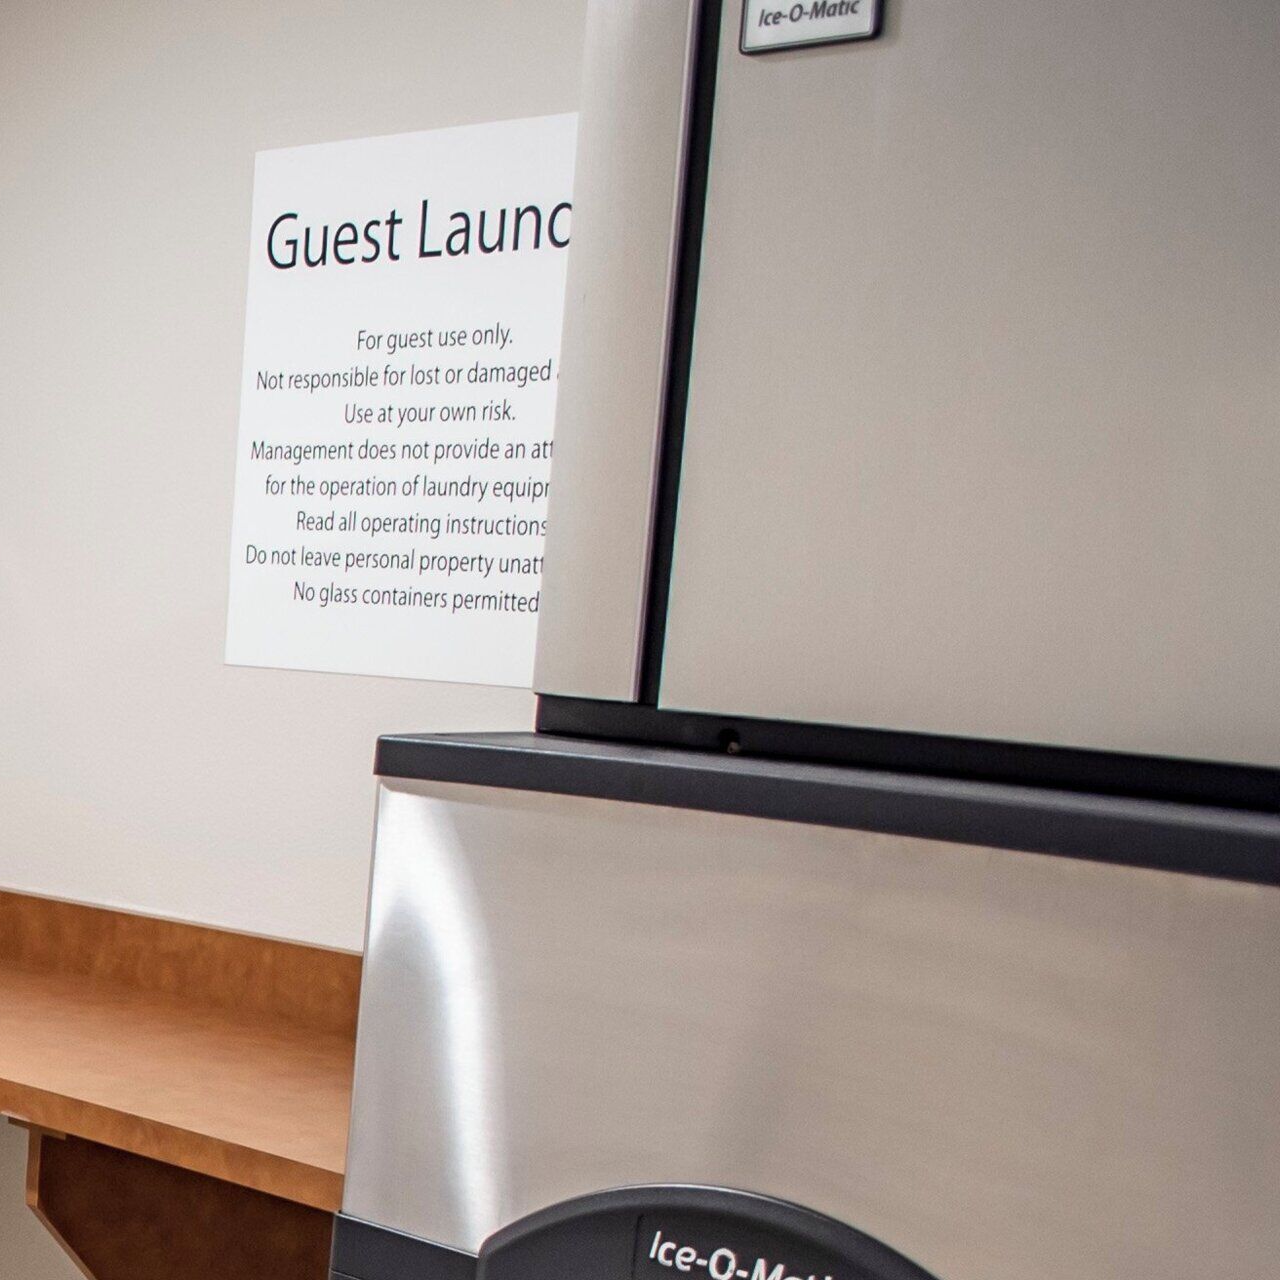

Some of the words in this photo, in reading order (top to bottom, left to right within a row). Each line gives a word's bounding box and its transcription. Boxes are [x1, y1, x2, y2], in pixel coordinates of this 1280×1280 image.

[758, 0, 860, 27] Ice-O-Matic
[266, 208, 403, 270] Guest
[357, 330, 383, 351] For
[386, 329, 433, 354] guest
[438, 328, 467, 346] use
[472, 322, 513, 351] only.
[256, 370, 284, 390] Not
[287, 365, 378, 394] responsible
[382, 364, 406, 386] for
[410, 363, 440, 386] lost
[445, 367, 463, 384] or
[467, 359, 552, 388] damaged
[344, 403, 373, 424] Use
[377, 404, 393, 423] at
[397, 405, 435, 428] your
[440, 404, 476, 423] own
[482, 399, 516, 422] risk.
[250, 440, 354, 465] Management
[357, 438, 397, 460] does
[400, 441, 430, 460] not
[434, 437, 500, 465] provide
[504, 442, 526, 459] an
[265, 474, 286, 497] for
[290, 474, 316, 496] the
[319, 475, 398, 501] operation
[401, 474, 420, 497] of
[423, 475, 488, 503] laundry
[296, 511, 334, 532] Read
[338, 511, 357, 532] all
[360, 513, 441, 539] operating
[446, 514, 547, 537] instructions
[245, 544, 268, 565] Do
[271, 547, 297, 567] not
[300, 546, 341, 569] leave
[344, 548, 415, 573] personal
[419, 555, 494, 578] property
[293, 581, 315, 602] No
[319, 583, 357, 607] glass
[361, 586, 448, 609] containers
[452, 590, 540, 614] permitted
